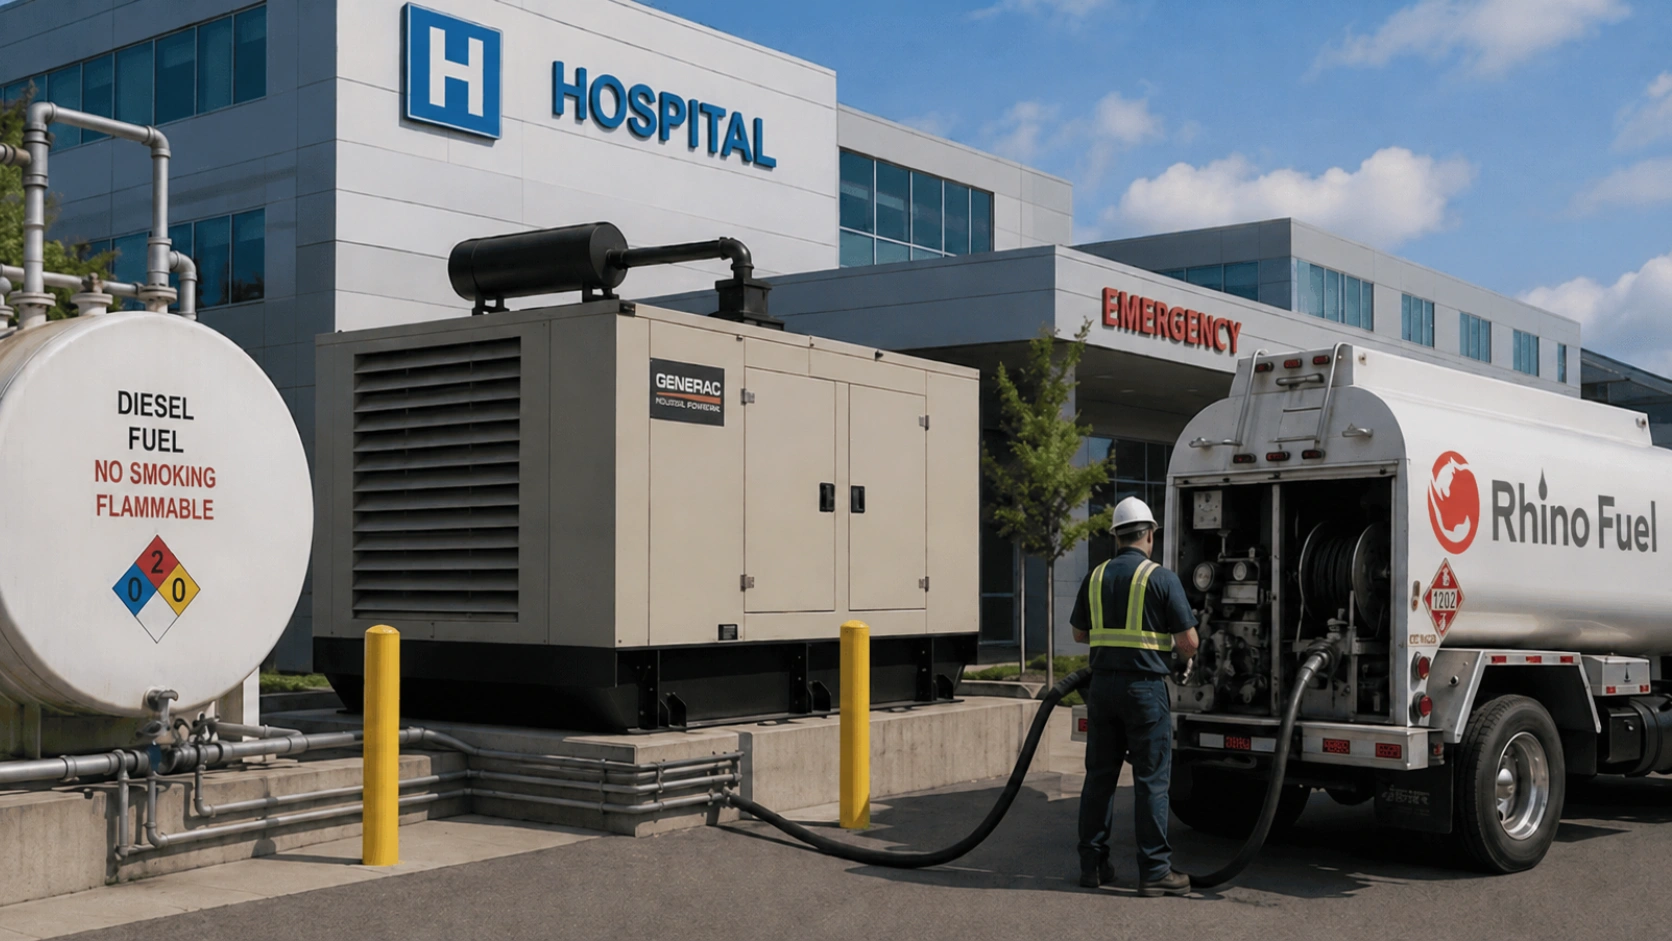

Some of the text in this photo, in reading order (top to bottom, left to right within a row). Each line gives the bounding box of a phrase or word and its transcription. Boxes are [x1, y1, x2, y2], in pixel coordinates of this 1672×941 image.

[429, 26, 484, 118] H
[552, 60, 777, 168] HOSPITAL
[1102, 286, 1242, 354] EMERGENCY
[656, 373, 721, 396] GENERAC
[118, 390, 194, 420] DIESEL
[129, 426, 184, 453] FUEL
[95, 459, 216, 488] NO SMOKING
[96, 493, 214, 520] FLAMMABLE
[1491, 467, 1658, 553] Rhino Fuel
[151, 550, 164, 574] 2
[128, 577, 142, 602] 0
[172, 577, 186, 603] 0
[1433, 591, 1456, 609] 1202
